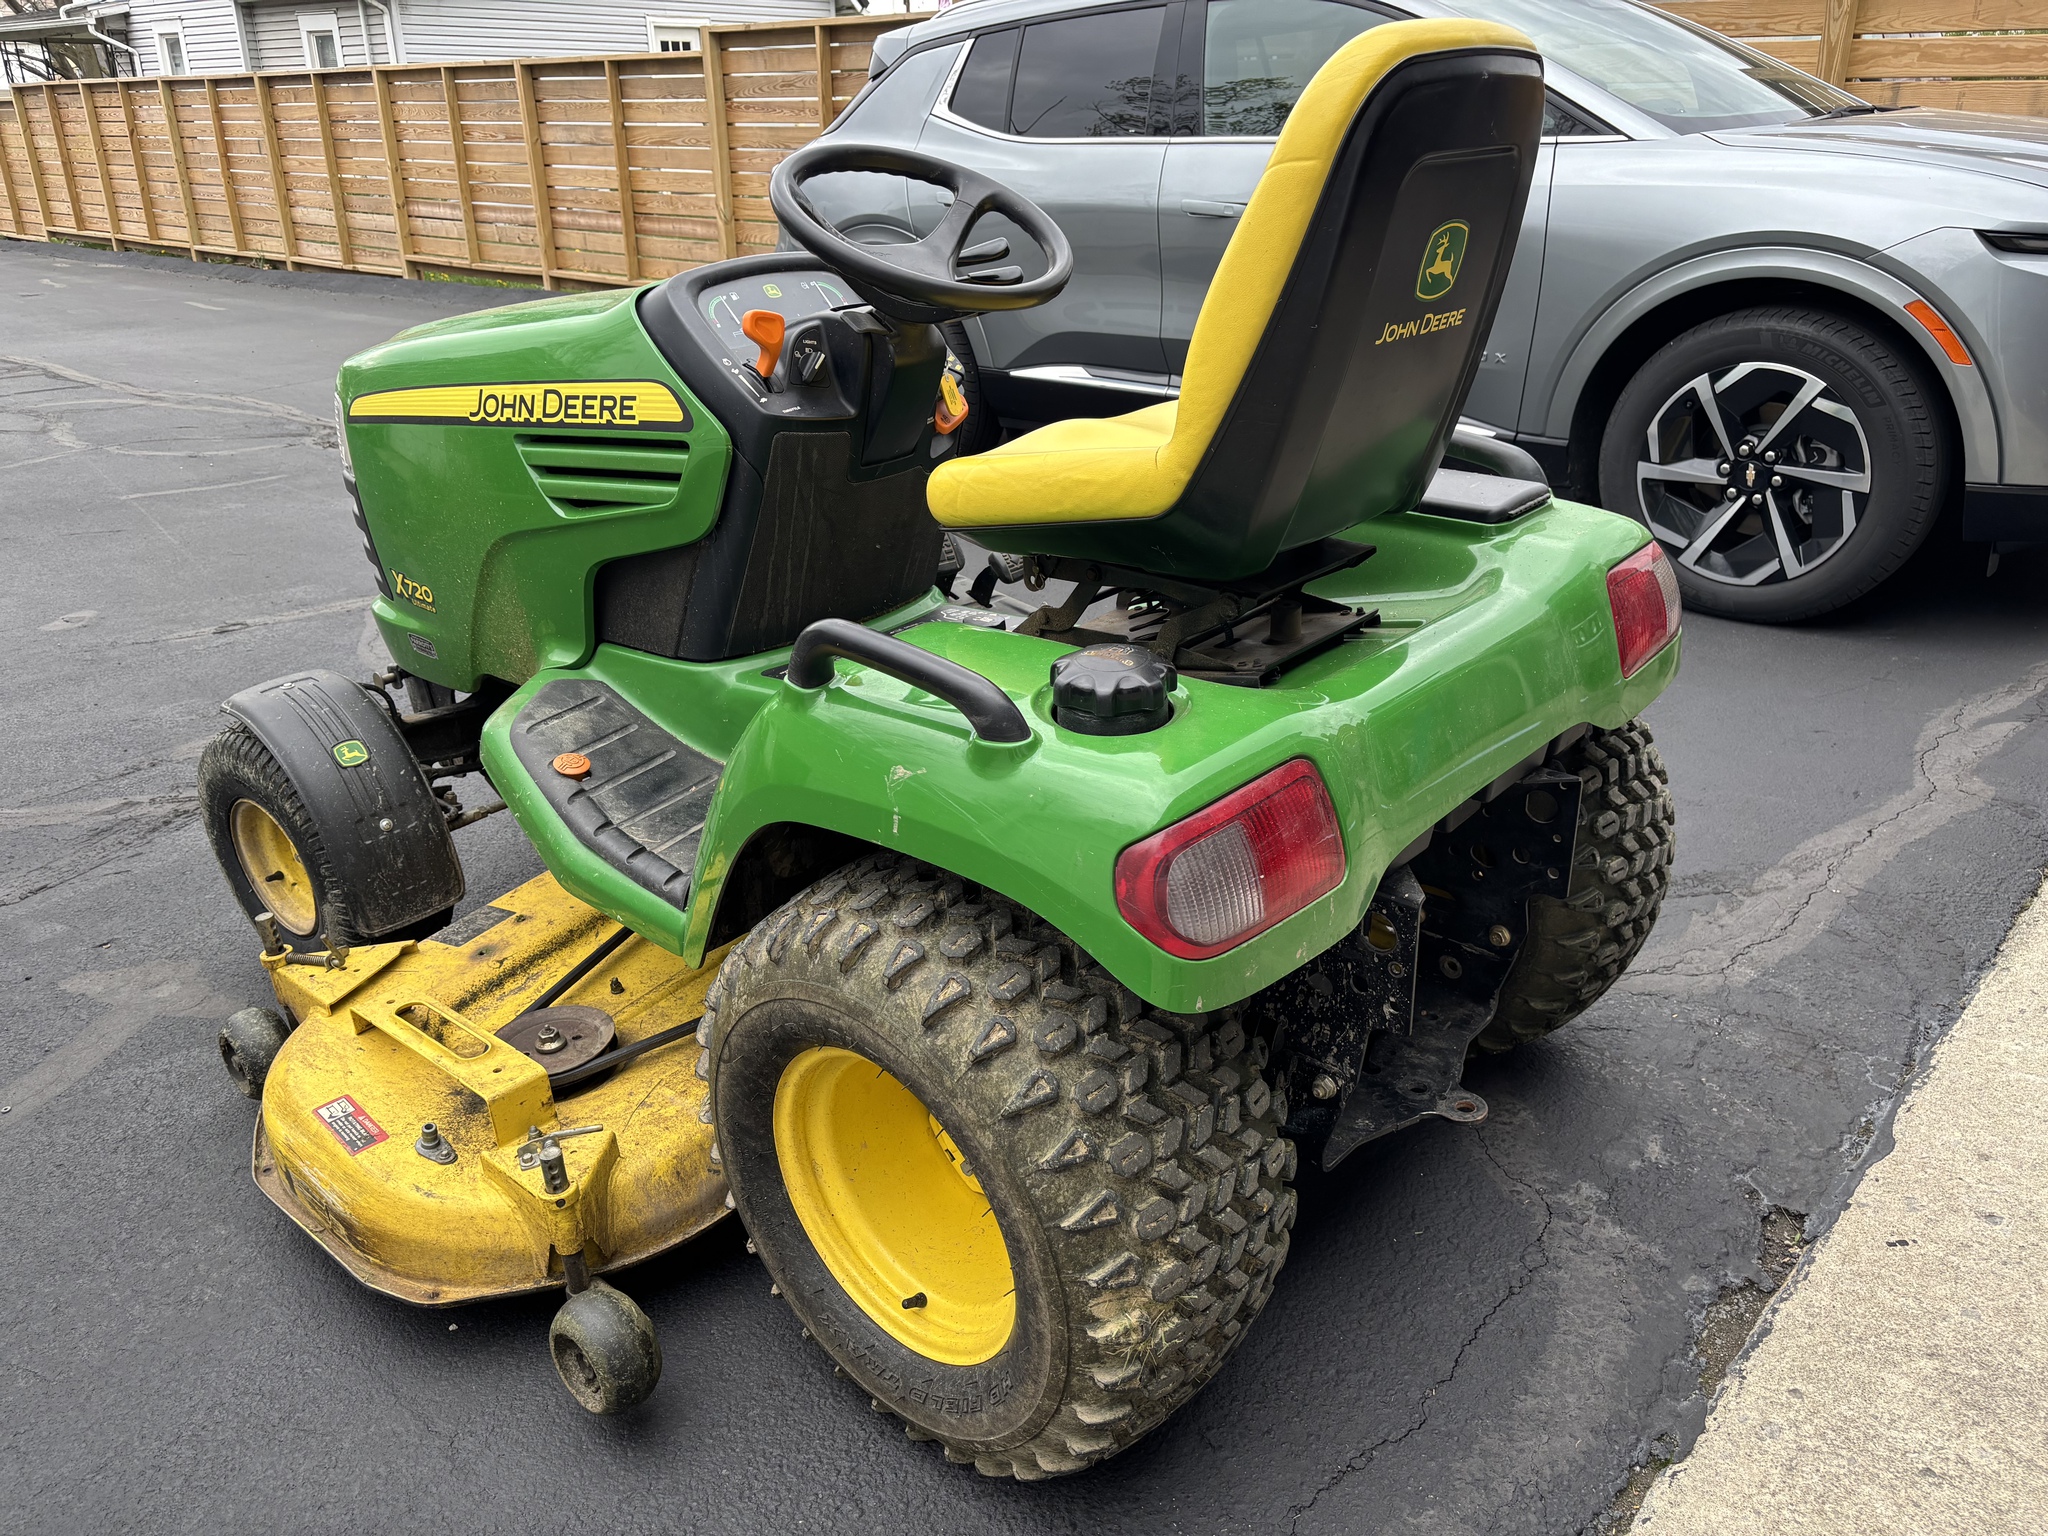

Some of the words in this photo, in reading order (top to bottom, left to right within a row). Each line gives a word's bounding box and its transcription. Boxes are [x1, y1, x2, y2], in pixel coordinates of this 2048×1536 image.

[1375, 320, 1420, 345] JOHN
[1420, 308, 1467, 335] DEERE
[1800, 342, 1881, 407] MICHELIN
[469, 388, 536, 418] JOHN
[541, 388, 637, 421] DEERE
[1883, 416, 1902, 467] PRIMACY
[390, 569, 434, 603] X720
[362, 1117, 380, 1134] DANGER
[817, 1312, 902, 1390] TRAX
[908, 1386, 984, 1415] FIELD
